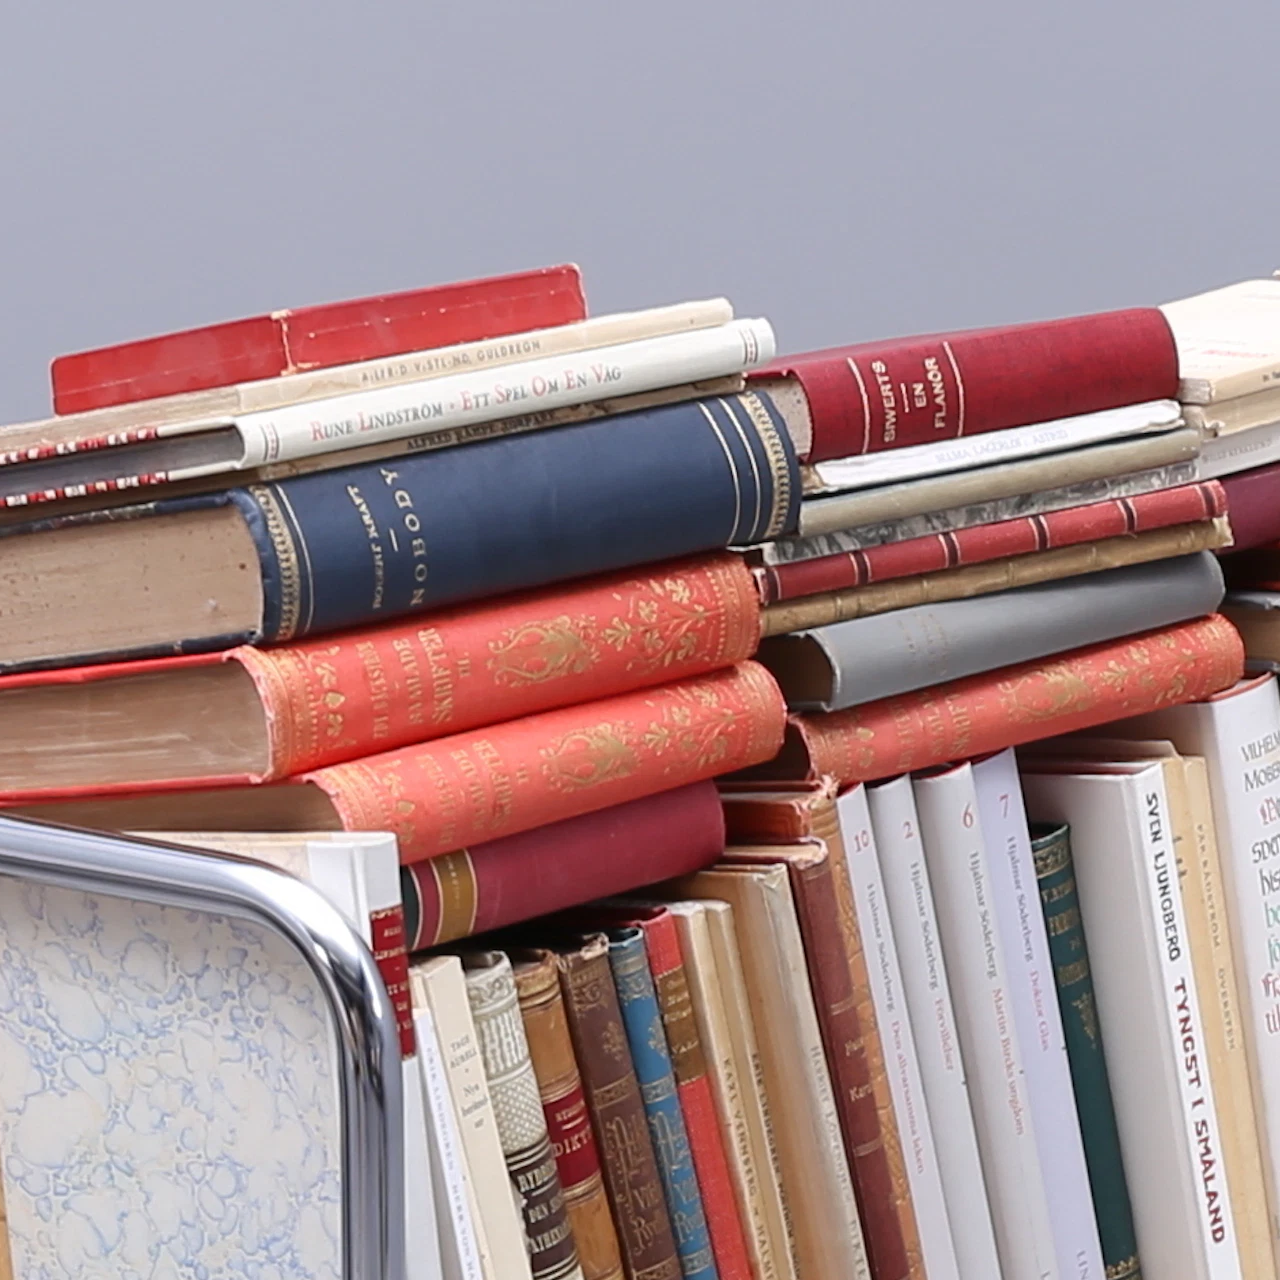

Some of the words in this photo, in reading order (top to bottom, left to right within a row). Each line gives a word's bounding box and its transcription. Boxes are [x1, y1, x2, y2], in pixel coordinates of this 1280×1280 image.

[476, 340, 542, 362] GULDREGN
[310, 418, 355, 442] RUNE
[358, 400, 444, 432] LINDSTRÖM
[460, 390, 491, 412] ETT
[494, 383, 528, 406] SPEL
[531, 376, 559, 397] OM
[564, 369, 588, 390] EN
[591, 363, 623, 384] VÅG
[871, 359, 897, 443] SIWERTS
[911, 382, 927, 409] EN
[346, 484, 380, 540] KRAFT
[380, 467, 428, 607] NOBODY
[369, 541, 385, 609] ROBERT
[392, 637, 424, 726] SAMLADE
[418, 627, 455, 725] SKRIFTER
[472, 738, 513, 834] SKRIFTER
[1145, 791, 1163, 844] SVEN
[998, 793, 1010, 819] 7
[1006, 835, 1022, 891] Hjalmar
[1016, 893, 1034, 962] Söderberg
[1028, 970, 1045, 1020] Doktor
[1037, 1019, 1049, 1052] Glas
[1154, 850, 1182, 963] LJUNGBERG
[854, 829, 870, 854] 10
[866, 882, 882, 938] Hjalmar
[877, 940, 896, 1013] Söderberg
[891, 1020, 900, 1051] Den
[896, 1054, 919, 1136] allvarsamma
[909, 861, 927, 918] Hjalmar
[921, 920, 939, 991] Söderberg
[934, 998, 955, 1073] Förvillelser
[961, 803, 974, 829] 6
[969, 850, 986, 908] Hjalmar
[979, 909, 998, 981] Söderberg
[992, 987, 1007, 1035] Martin
[1008, 1082, 1025, 1137] ungdom
[449, 1048, 479, 1070] AURELL
[450, 1033, 471, 1053] TAGE
[750, 1052, 763, 1088] ERIK
[810, 1044, 830, 1102] HARRIET
[1172, 976, 1204, 1090] TYNGST
[1191, 1097, 1205, 1112] I
[733, 1110, 757, 1198] VENNBERG
[1192, 1120, 1226, 1245] SMÅLAND
